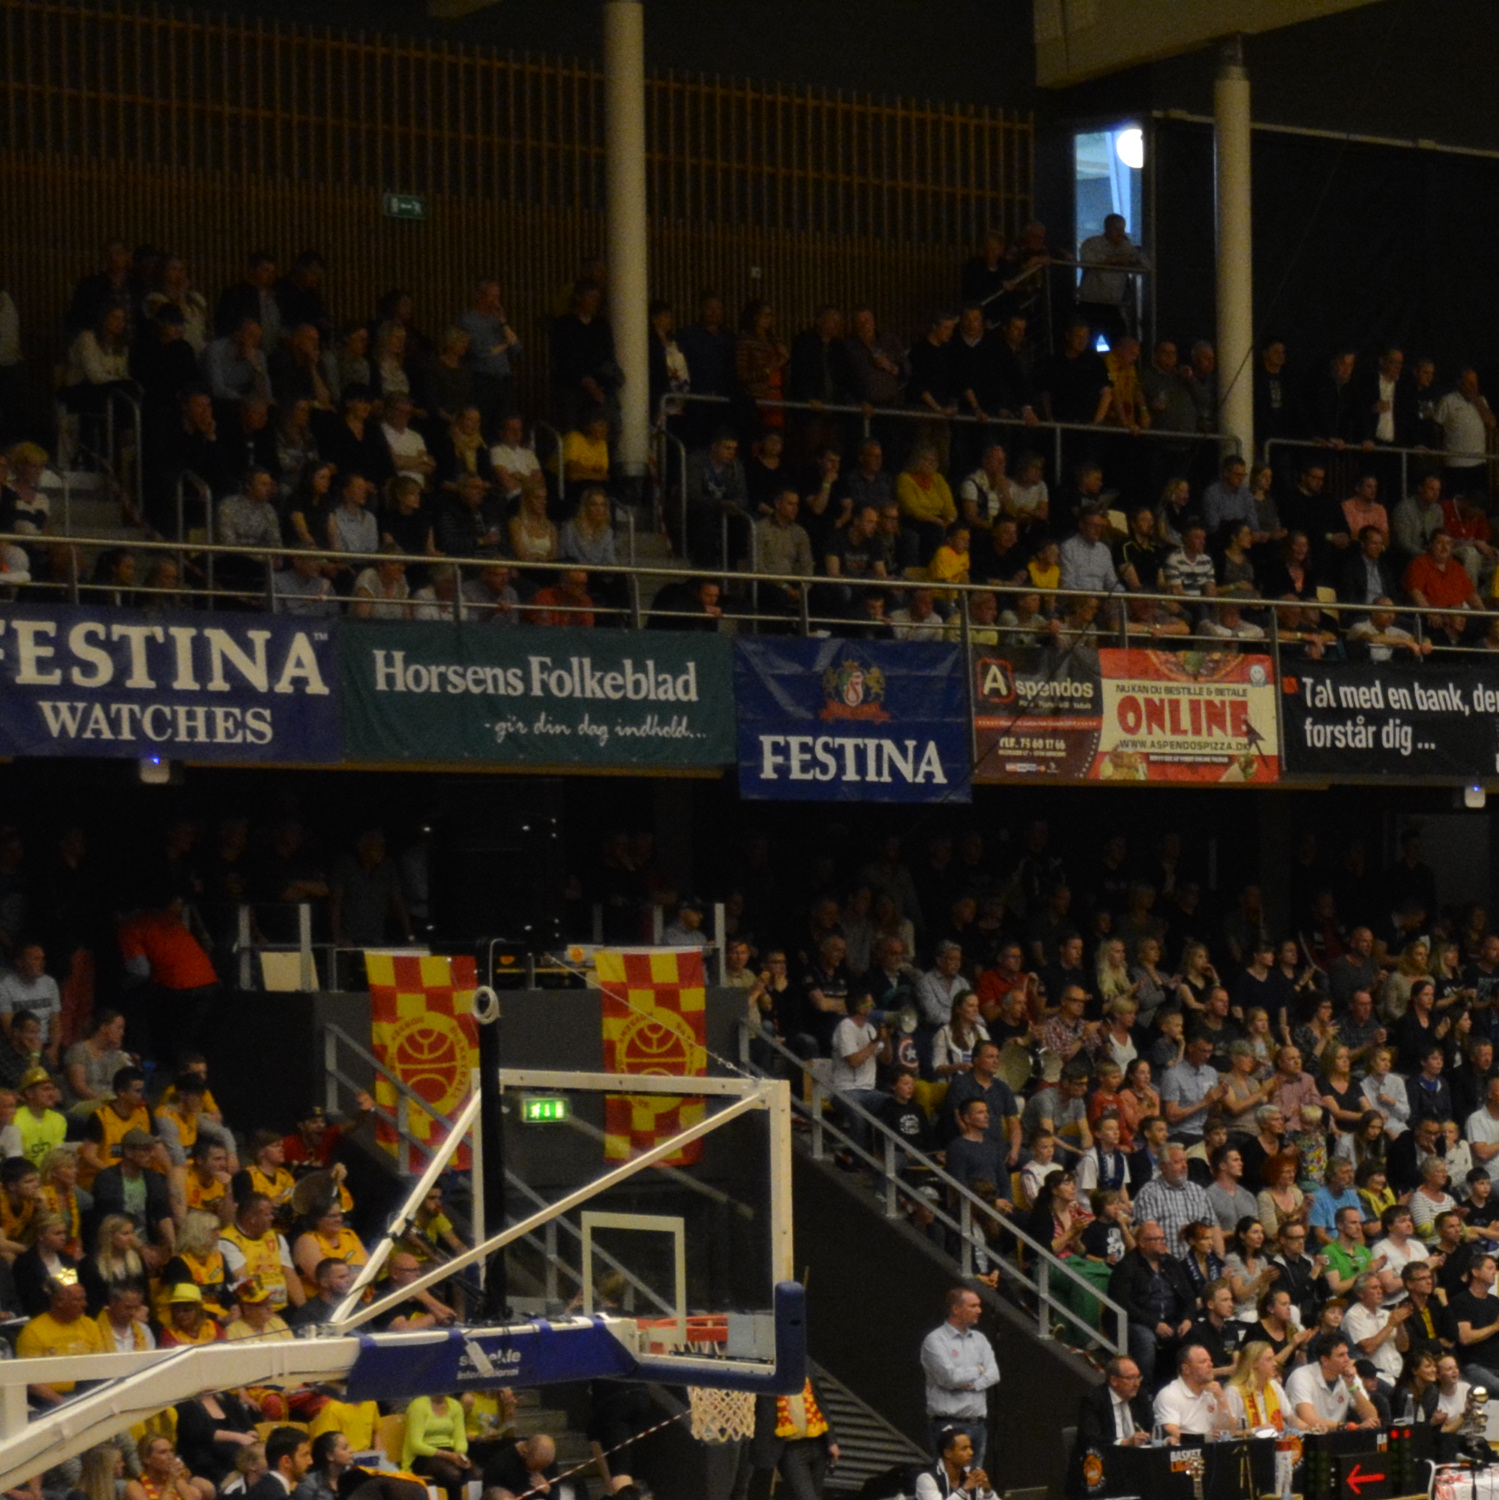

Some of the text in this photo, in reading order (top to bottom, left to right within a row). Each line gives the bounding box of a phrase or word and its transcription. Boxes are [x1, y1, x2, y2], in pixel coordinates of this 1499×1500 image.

[0, 619, 330, 695] ESTINA
[373, 649, 699, 702] Horsens Folkeblad
[983, 664, 1094, 700] Aspendos
[1164, 686, 1204, 696] BESTILLE
[1215, 687, 1248, 697] BETALE
[1301, 677, 1336, 707] Tal
[1341, 680, 1385, 709] med
[1389, 687, 1412, 709] en
[1413, 681, 1470, 716] bank,
[38, 701, 274, 744] WATCHES
[533, 712, 571, 736] din
[578, 713, 609, 747] dag
[1117, 695, 1249, 737] ONLINE
[1304, 715, 1413, 756] forstår dig
[759, 734, 948, 785] FESTINA
